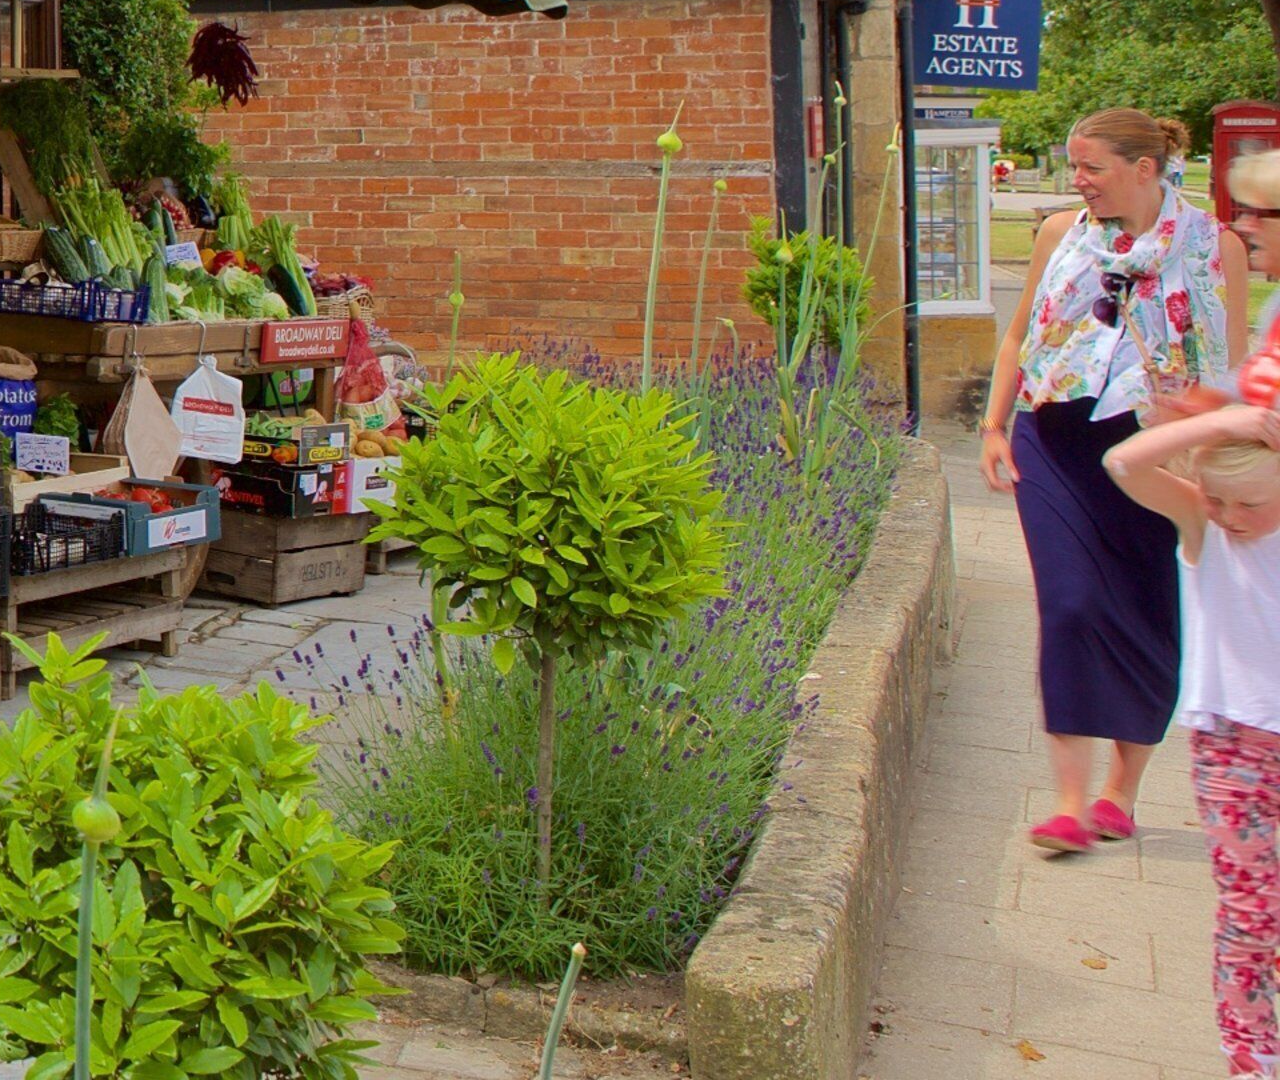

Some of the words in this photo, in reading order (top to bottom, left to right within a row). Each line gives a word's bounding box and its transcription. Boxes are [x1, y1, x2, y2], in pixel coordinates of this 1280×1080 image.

[933, 33, 1018, 54] ESTATE
[926, 56, 1023, 78] AGENTS
[275, 326, 325, 343] BROADWAY
[326, 325, 343, 341] DELI
